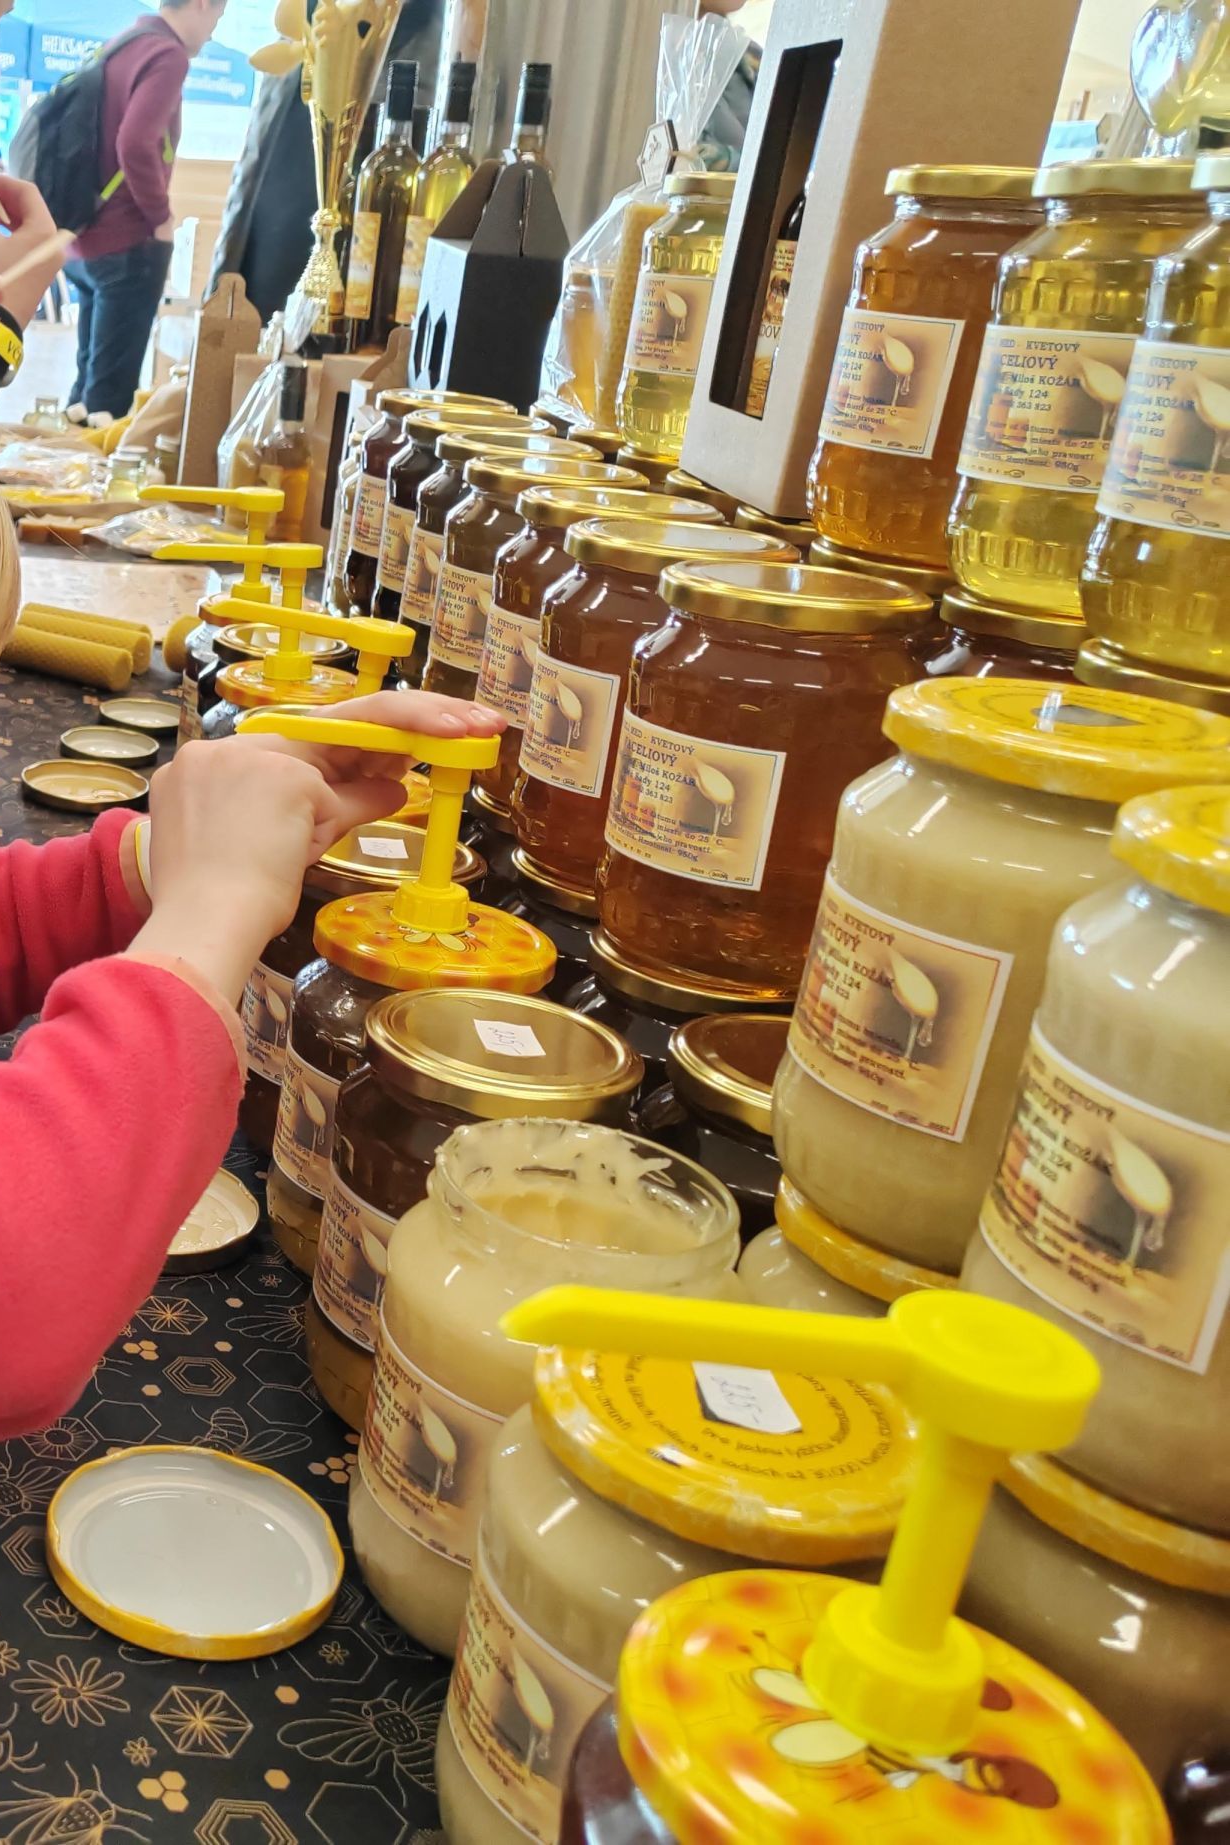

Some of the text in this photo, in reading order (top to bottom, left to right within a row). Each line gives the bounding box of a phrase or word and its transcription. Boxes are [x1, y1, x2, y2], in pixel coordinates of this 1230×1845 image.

[1026, 340, 1081, 353] KVETOVÝ
[999, 353, 1059, 370] CELIOVÝ
[1028, 389, 1049, 399] 124
[650, 735, 696, 757] KVETOVÝ
[655, 780, 671, 792] 124
[645, 789, 674, 804] 363 823
[698, 834, 710, 844] 25
[842, 971, 862, 992] 124
